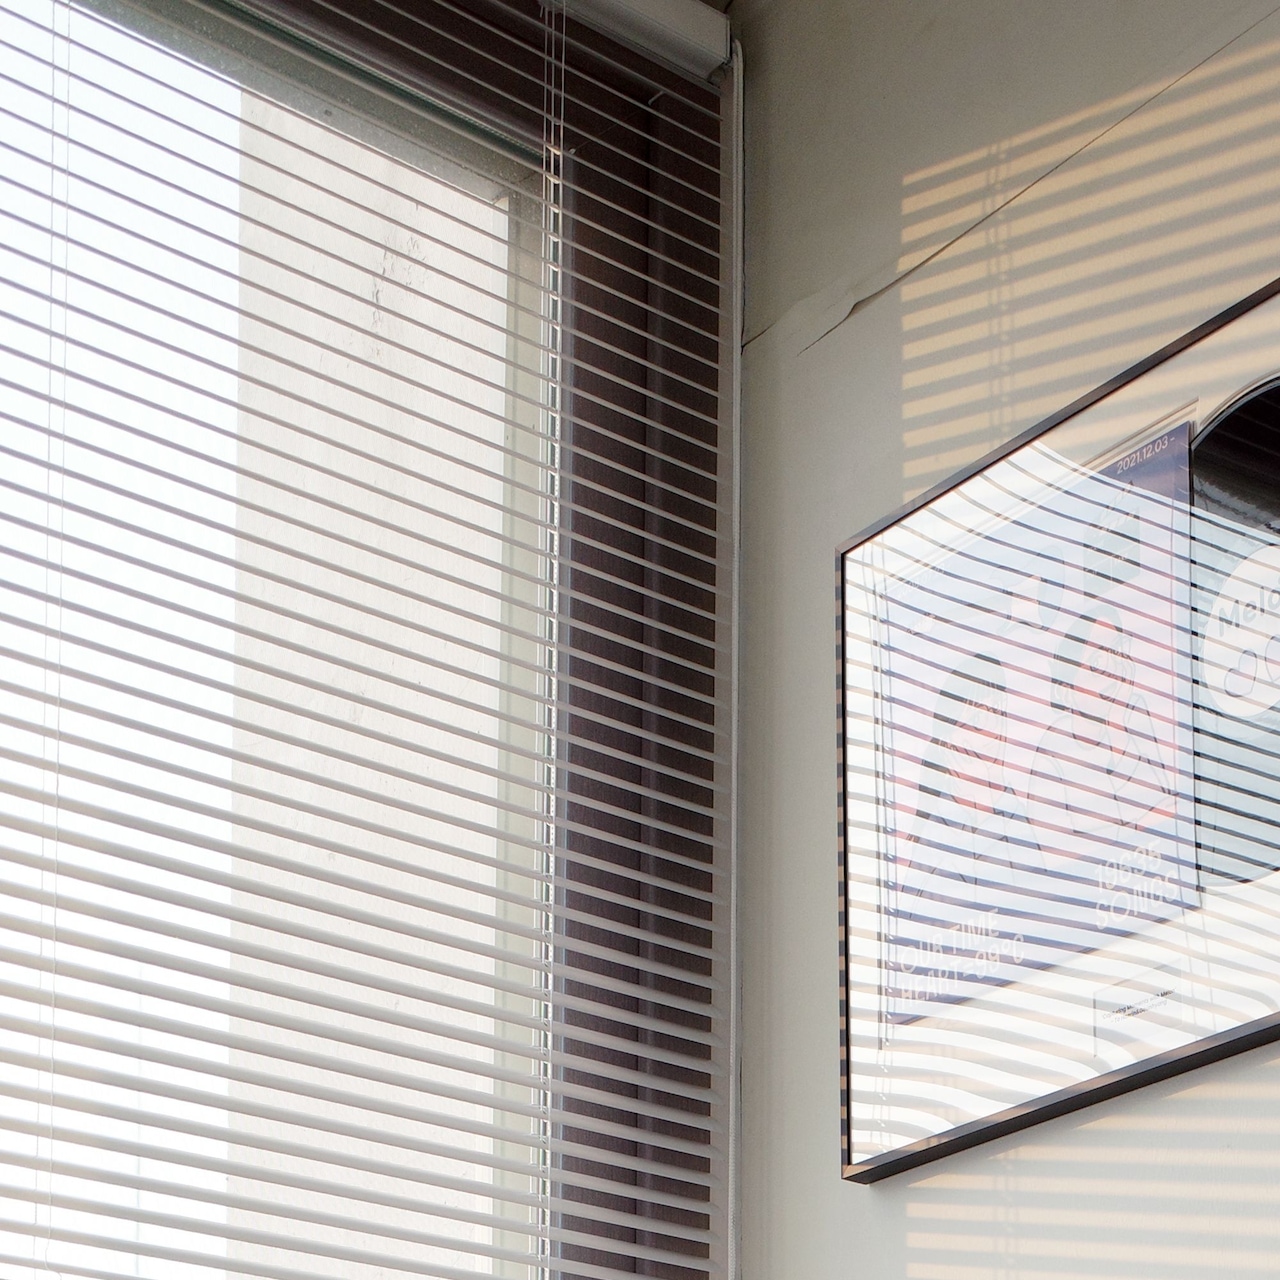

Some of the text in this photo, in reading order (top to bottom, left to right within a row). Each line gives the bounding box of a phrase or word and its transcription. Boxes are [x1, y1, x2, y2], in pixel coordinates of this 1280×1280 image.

[1117, 435, 1168, 474] 2021.12.03
[1095, 839, 1162, 894] 19635
[1095, 871, 1180, 930] SONGS
